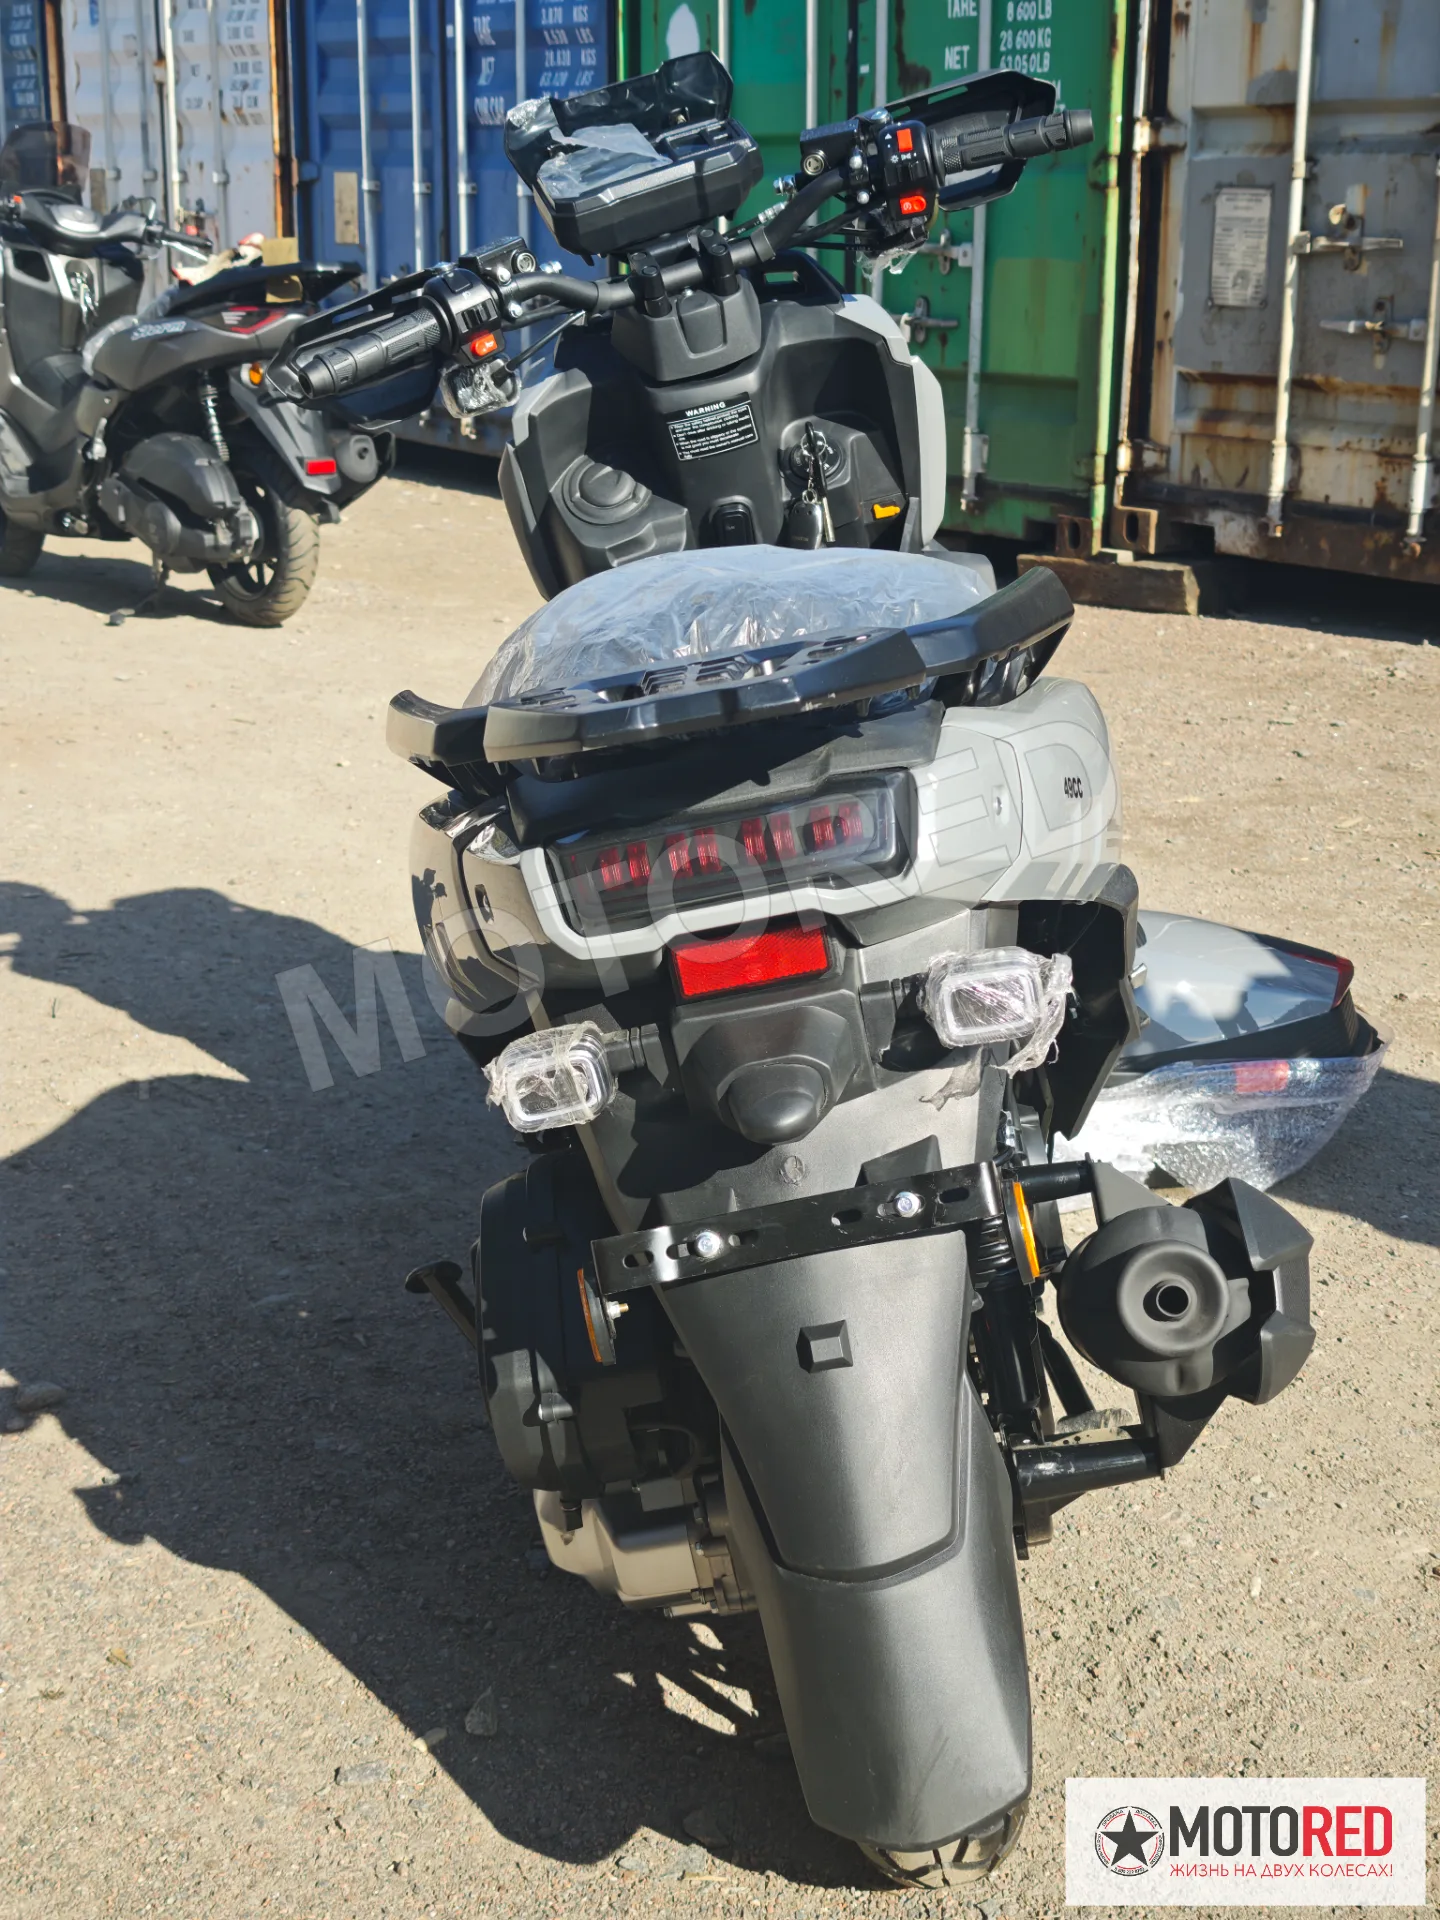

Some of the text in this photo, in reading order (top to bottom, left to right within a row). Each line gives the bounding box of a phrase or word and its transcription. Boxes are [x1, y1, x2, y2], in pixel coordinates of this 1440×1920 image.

[944, 45, 970, 71] NET
[685, 401, 726, 417] WARNING
[1064, 776, 1084, 799] 49CC
